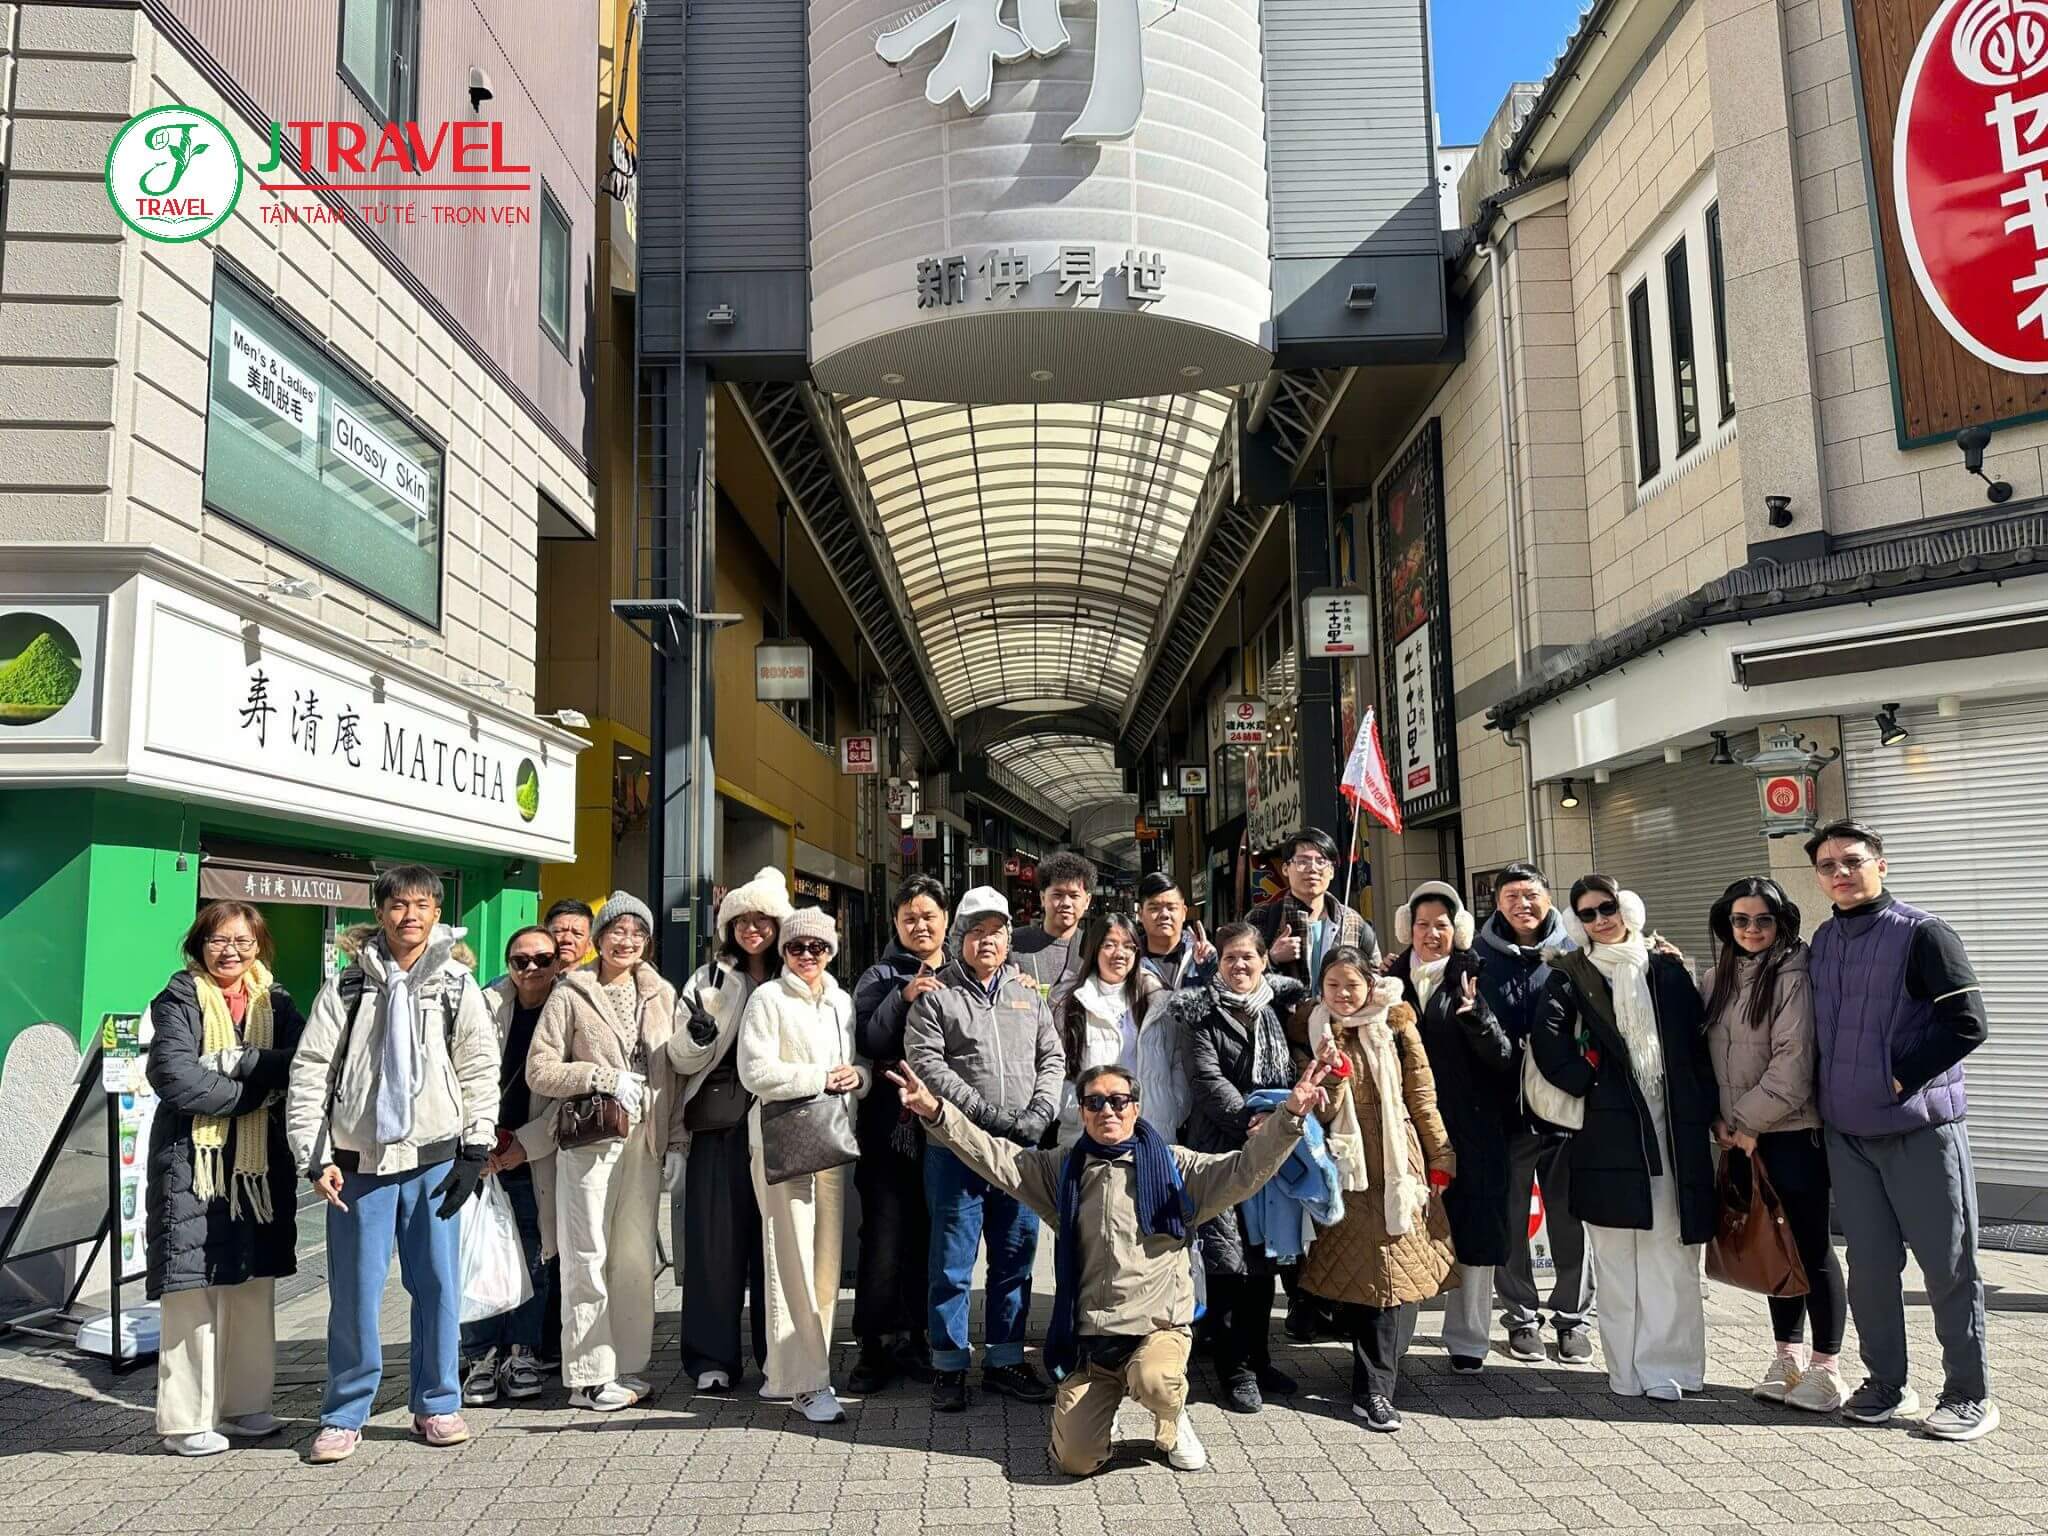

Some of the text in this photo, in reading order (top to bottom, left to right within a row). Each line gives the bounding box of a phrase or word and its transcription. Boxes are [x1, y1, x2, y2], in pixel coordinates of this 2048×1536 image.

[916, 245, 1167, 310] 新仲見世
[233, 331, 317, 404] Men's & Ladies'
[247, 365, 304, 424] 美肌脱毛
[336, 418, 425, 503] Glossy Skin
[1325, 599, 1343, 644] 土古里
[238, 668, 506, 804] 寿清庵 MATCHA
[1230, 732, 1262, 741] 24時間
[1402, 646, 1421, 769] 土古里
[291, 879, 343, 901] MATCHA
